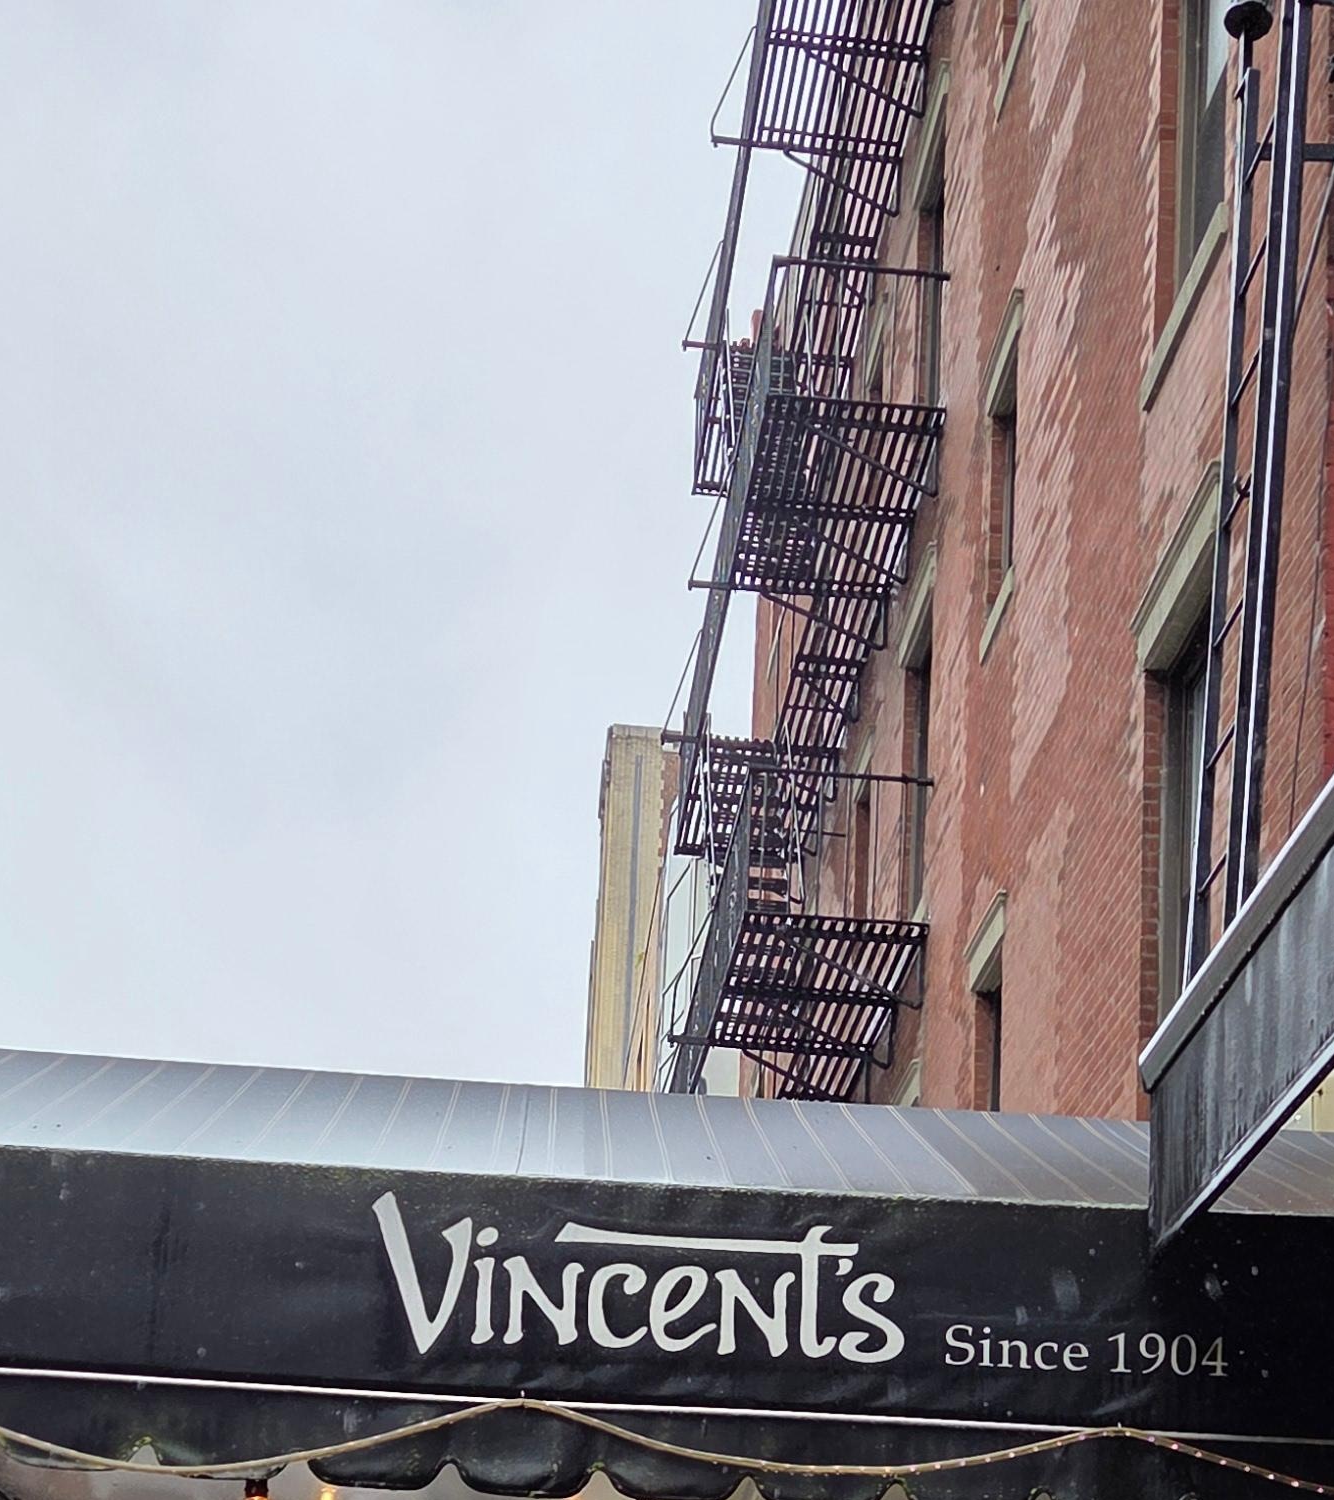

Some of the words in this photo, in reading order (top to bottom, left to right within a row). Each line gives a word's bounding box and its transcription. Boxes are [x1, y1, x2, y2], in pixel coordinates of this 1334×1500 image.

[371, 1191, 906, 1363] Vincent's
[943, 1322, 1090, 1374] Since
[1109, 1331, 1229, 1378] 1904
